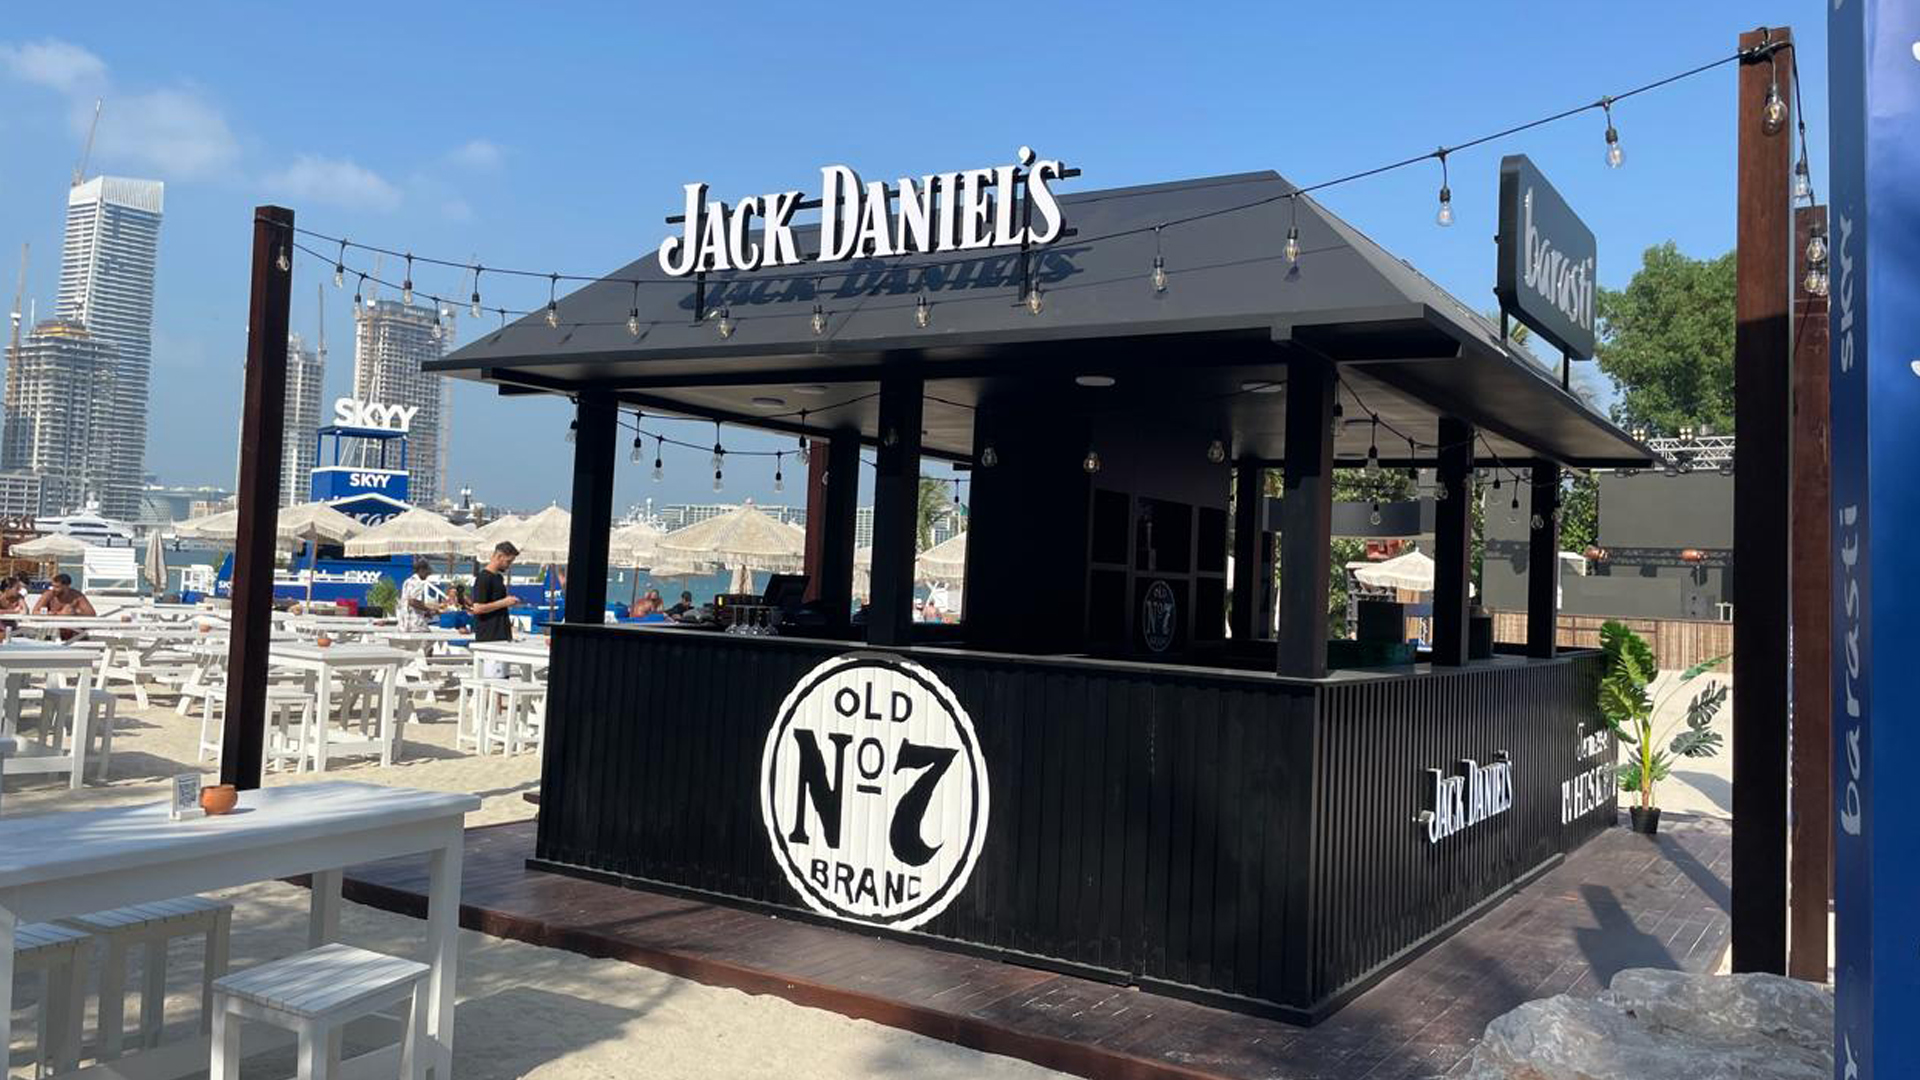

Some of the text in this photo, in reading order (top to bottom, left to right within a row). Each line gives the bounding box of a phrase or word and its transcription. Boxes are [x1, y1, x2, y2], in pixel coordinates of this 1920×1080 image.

[659, 145, 1068, 277] JACK DANIEL'S
[1524, 186, 1594, 331] barasti
[1839, 212, 1855, 374] SKYY
[333, 397, 419, 432] SKYY
[350, 473, 391, 488] SKYY
[834, 681, 913, 723] OLD
[1839, 505, 1862, 836] barasti
